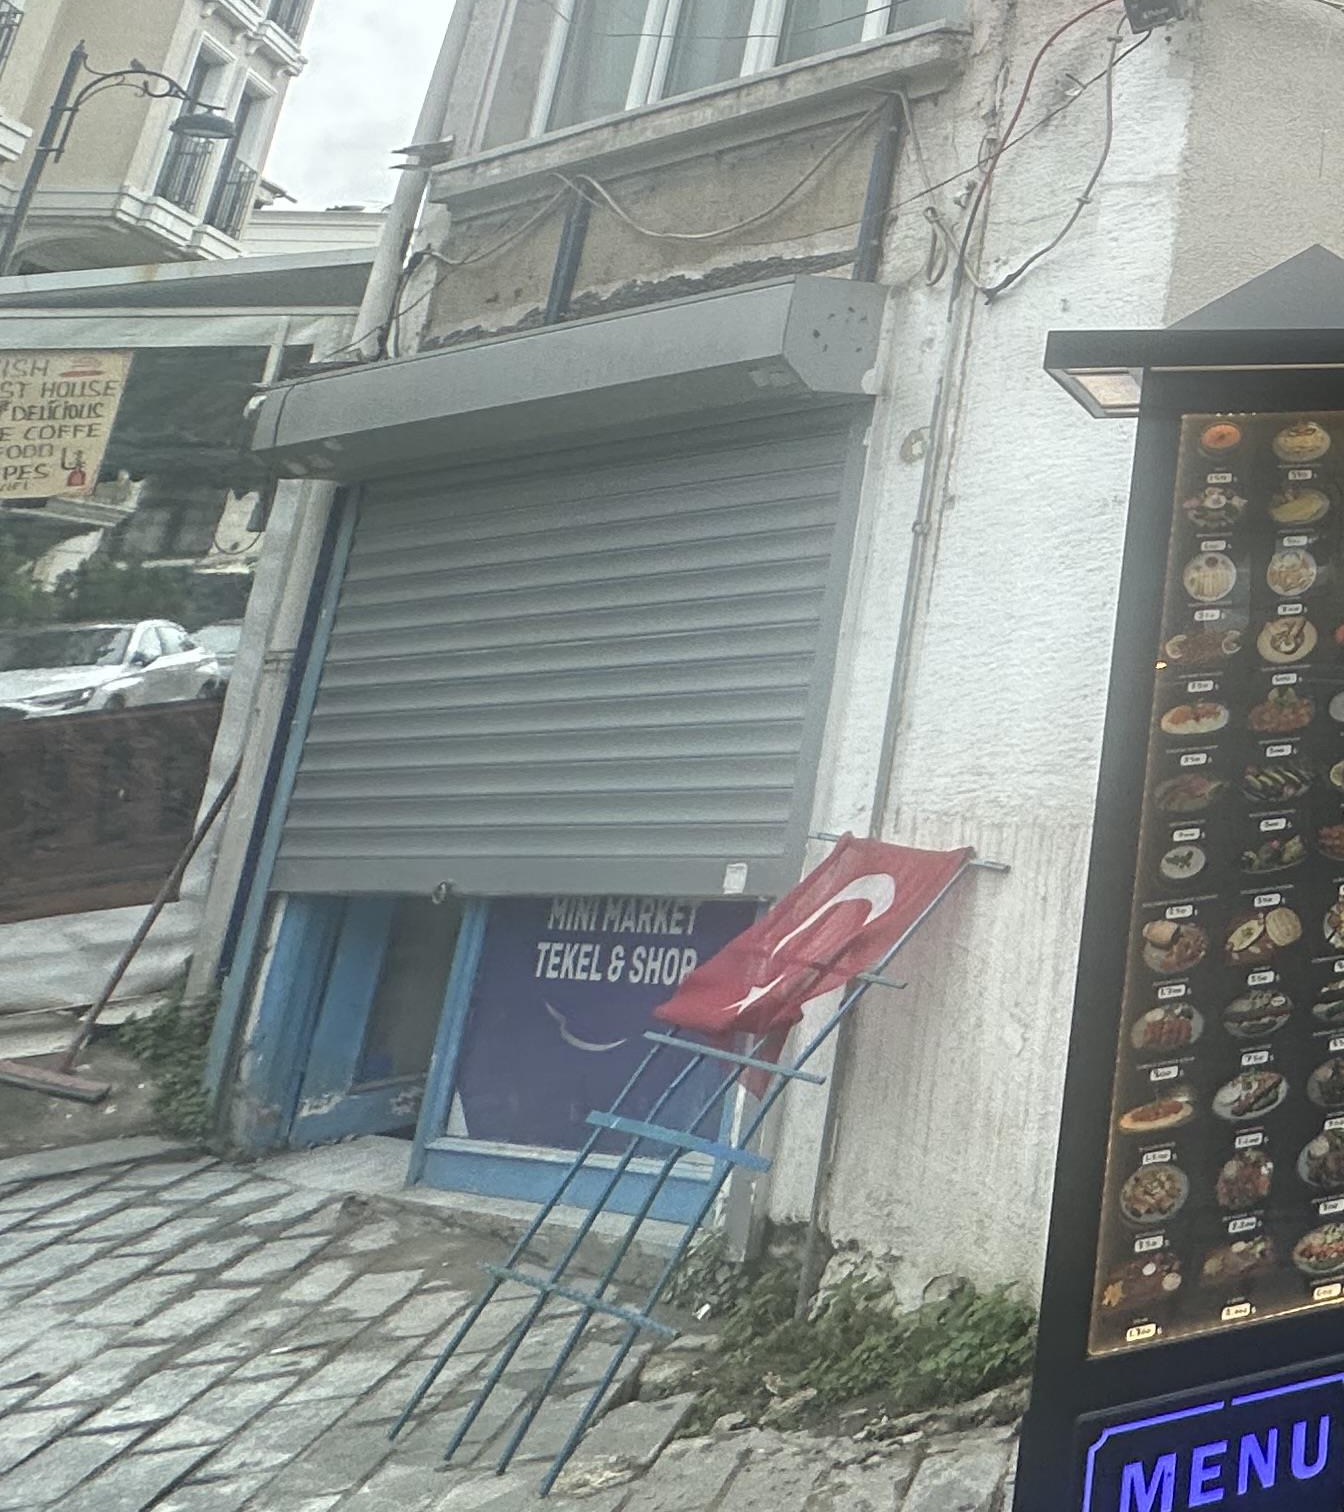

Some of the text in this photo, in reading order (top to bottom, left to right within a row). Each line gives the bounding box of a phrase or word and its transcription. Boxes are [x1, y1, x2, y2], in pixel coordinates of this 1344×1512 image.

[40, 380, 121, 398] HOUSE
[24, 423, 103, 440] COFFE
[547, 895, 700, 935] MINI MARKET
[535, 942, 698, 985] TEKEL & SHOP
[1119, 1415, 1330, 1512] MENU
